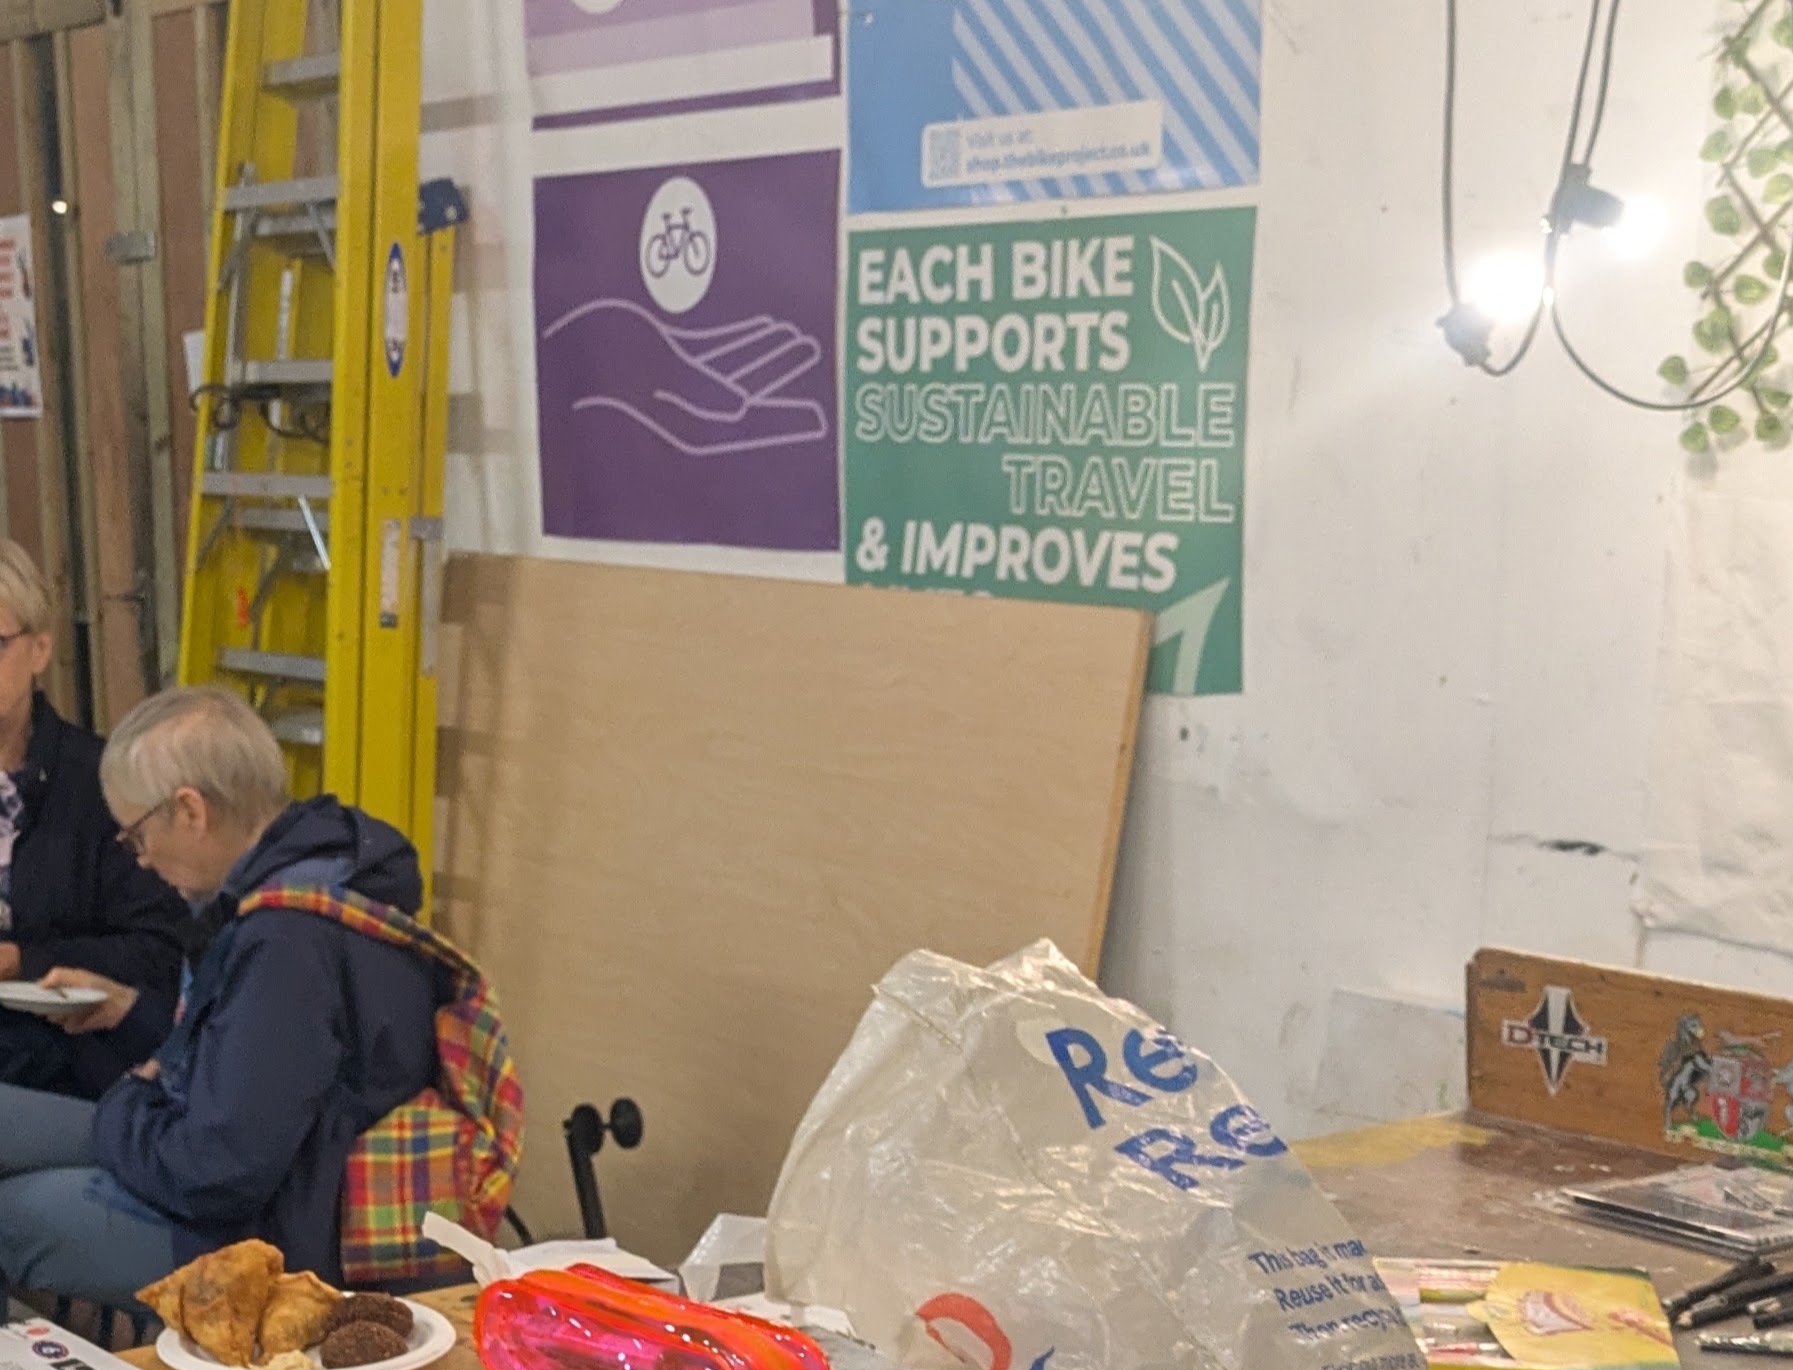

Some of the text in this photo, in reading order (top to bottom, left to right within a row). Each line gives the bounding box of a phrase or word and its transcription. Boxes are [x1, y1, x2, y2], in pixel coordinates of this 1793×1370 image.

[858, 235, 1136, 306] EACH BIKE
[856, 311, 1131, 374] SUPPORTS
[854, 382, 1237, 448] SUSTAINABLE
[1001, 453, 1235, 524] TRAVEL
[855, 517, 1180, 594] & IMPROVES
[1273, 1283, 1334, 1312] Reuse
